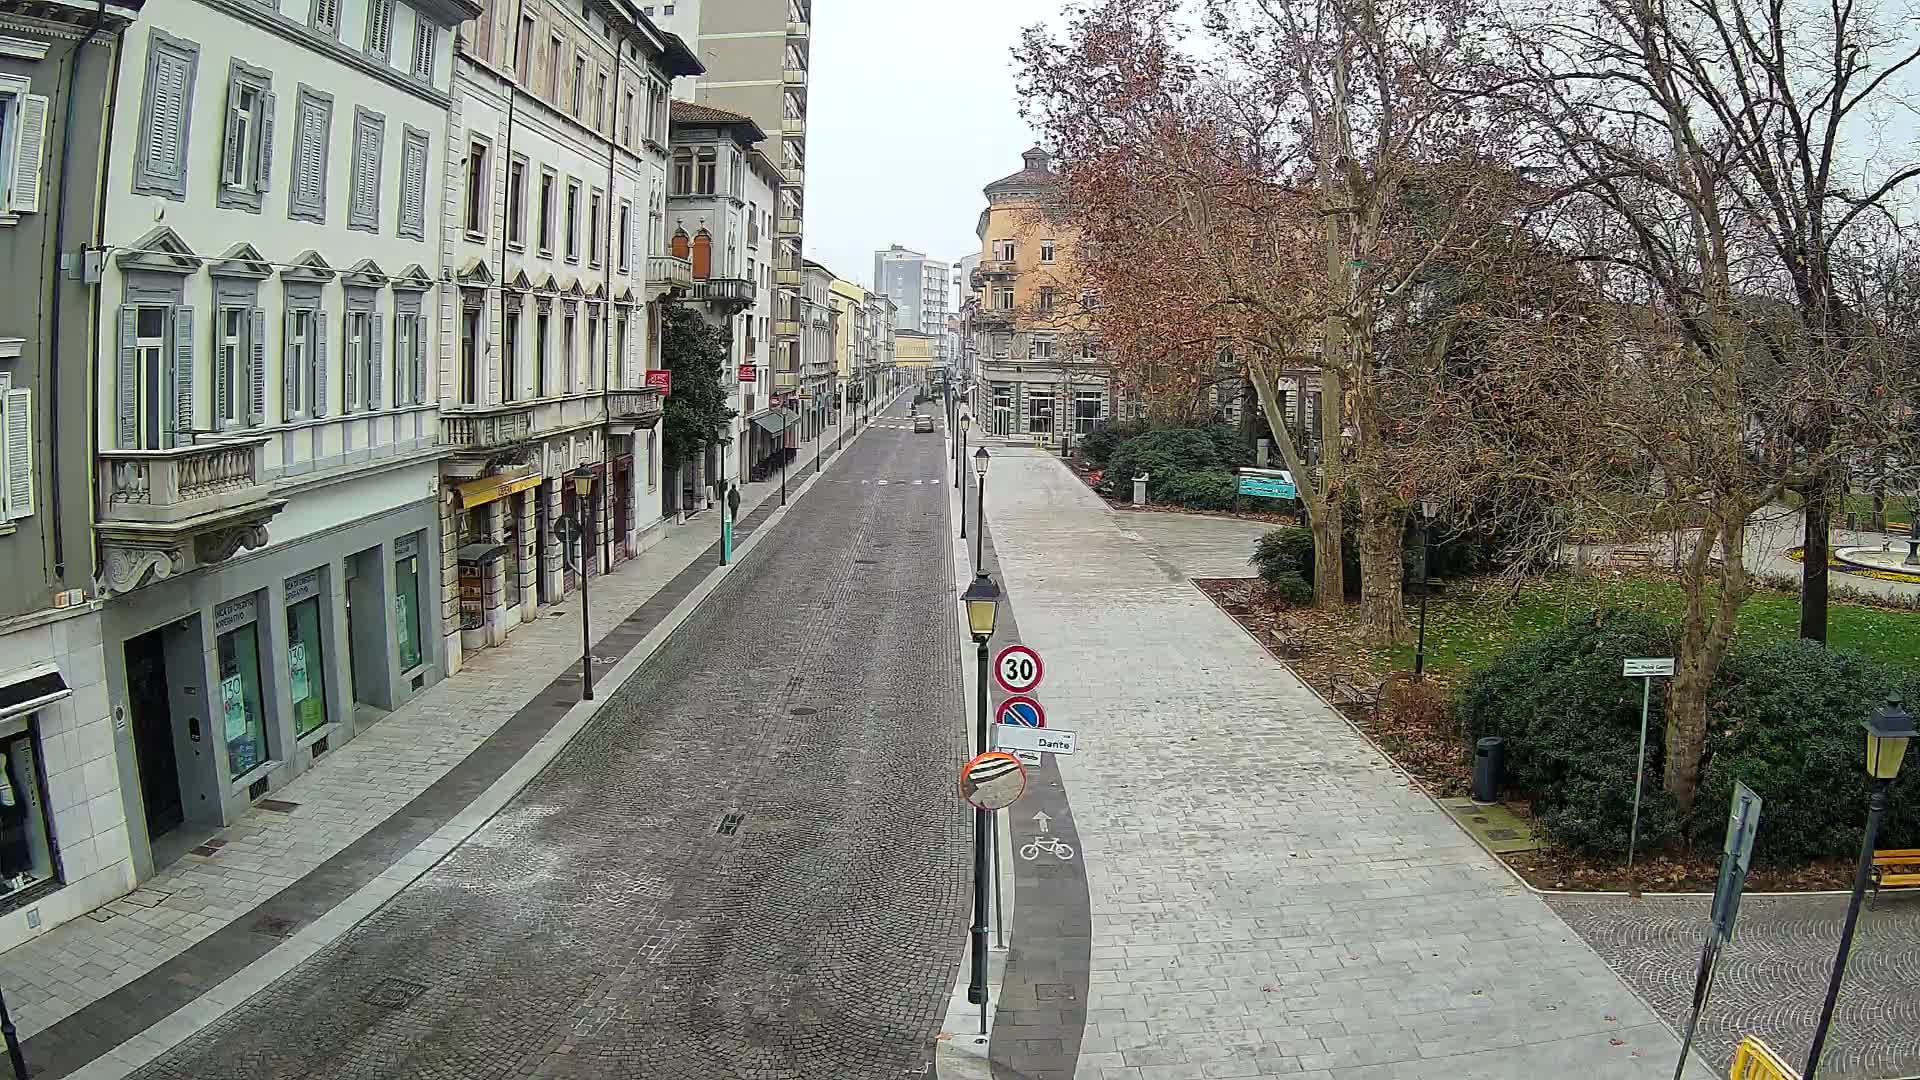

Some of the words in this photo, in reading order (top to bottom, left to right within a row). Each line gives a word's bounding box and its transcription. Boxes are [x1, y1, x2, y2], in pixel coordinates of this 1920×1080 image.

[1005, 659, 1033, 680] 30
[222, 677, 241, 700] 130
[1038, 738, 1070, 750] Dante
